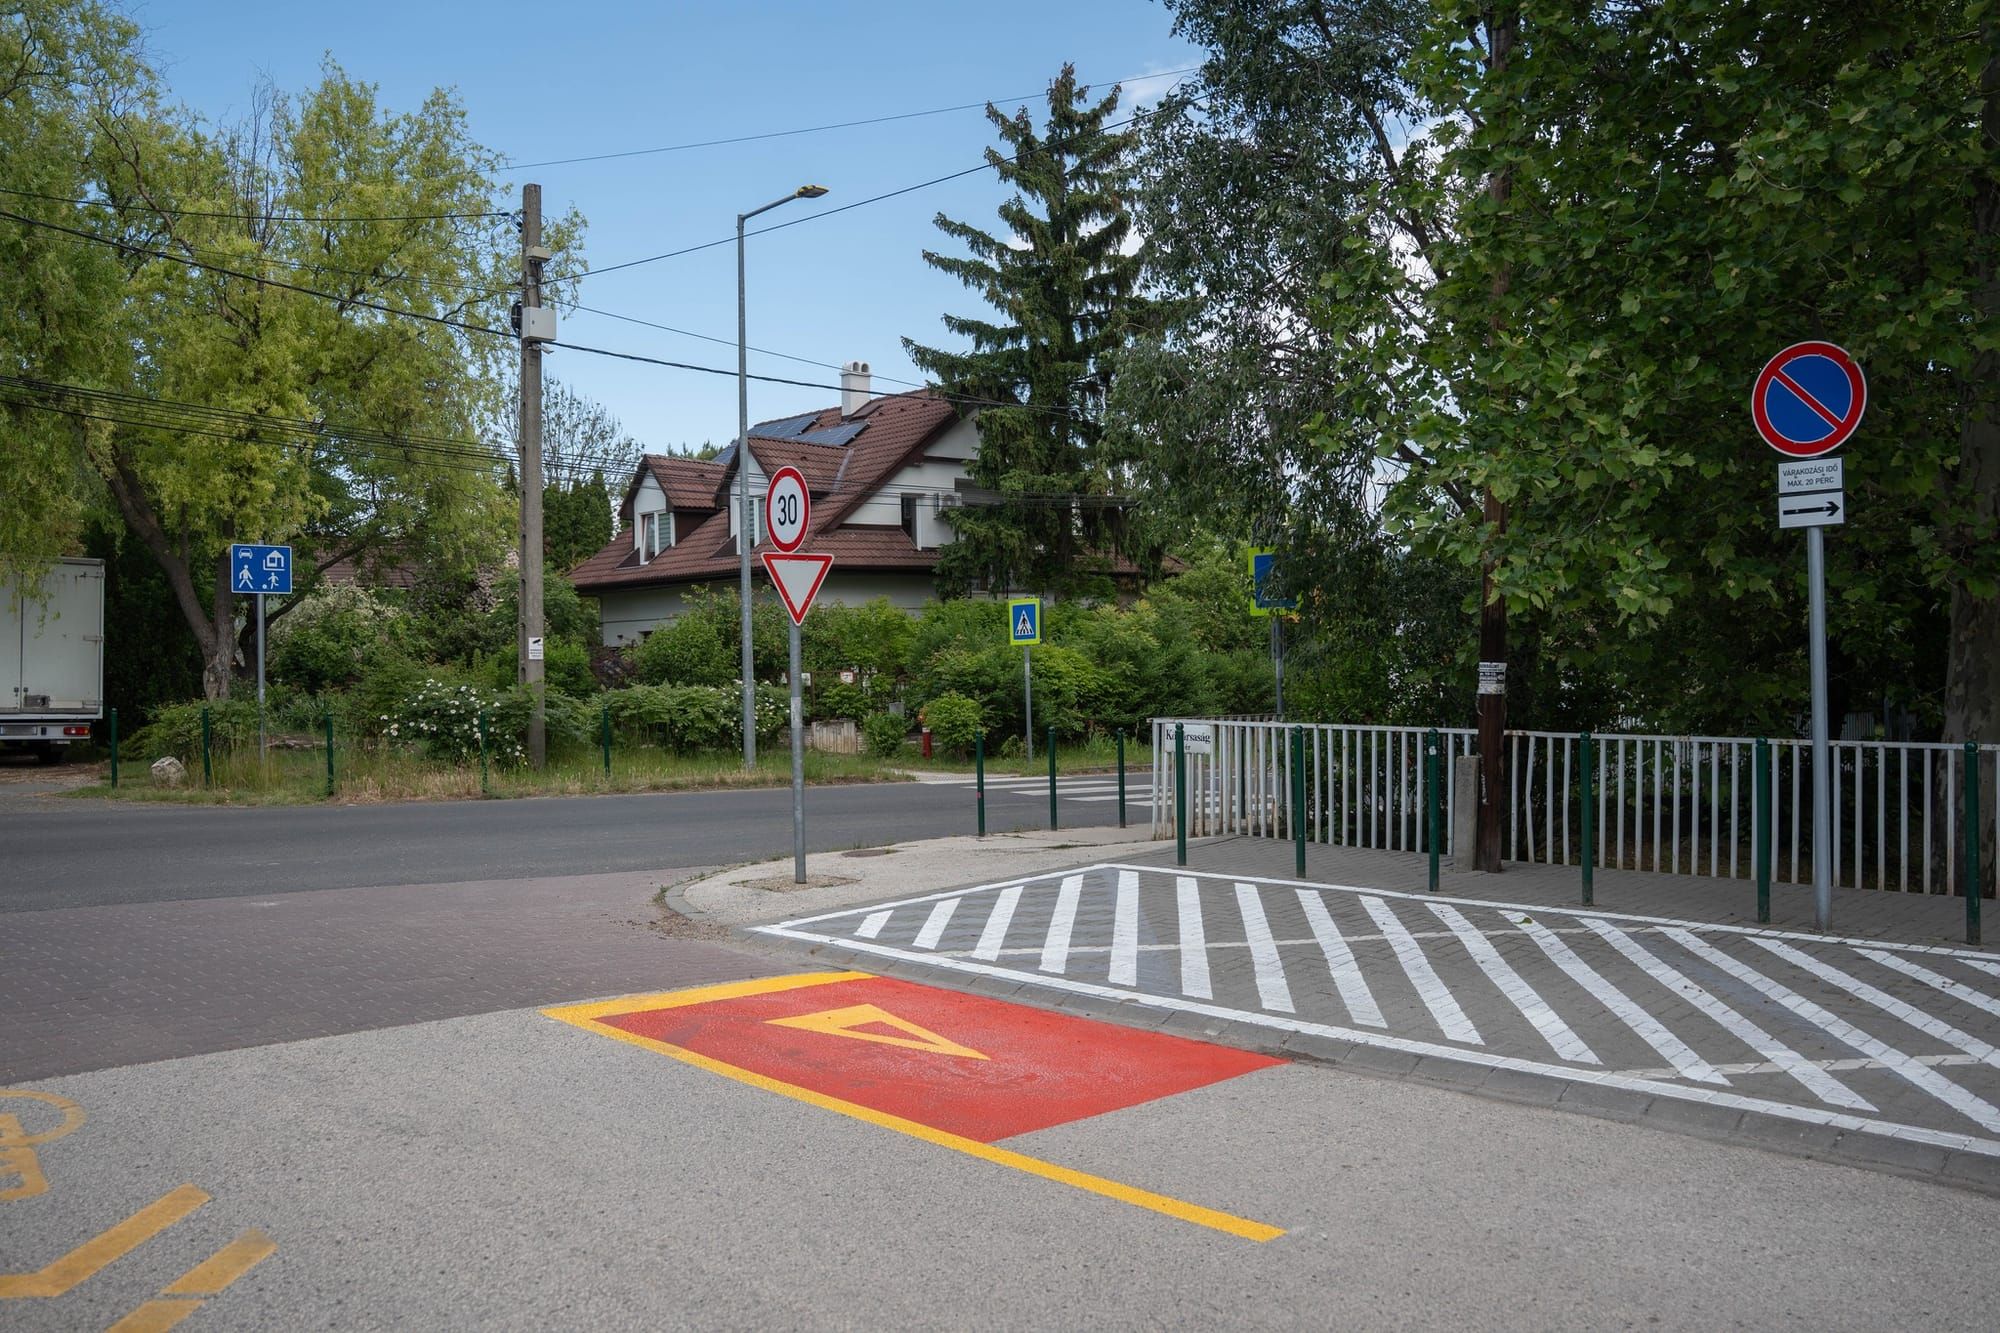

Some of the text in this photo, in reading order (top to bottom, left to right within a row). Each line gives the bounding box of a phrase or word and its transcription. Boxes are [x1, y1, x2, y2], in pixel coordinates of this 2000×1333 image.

[1782, 465, 1824, 477] VÁRAKOZÁSI
[1787, 476, 1834, 487] MAX. 20 PERC
[777, 493, 798, 526] 30
